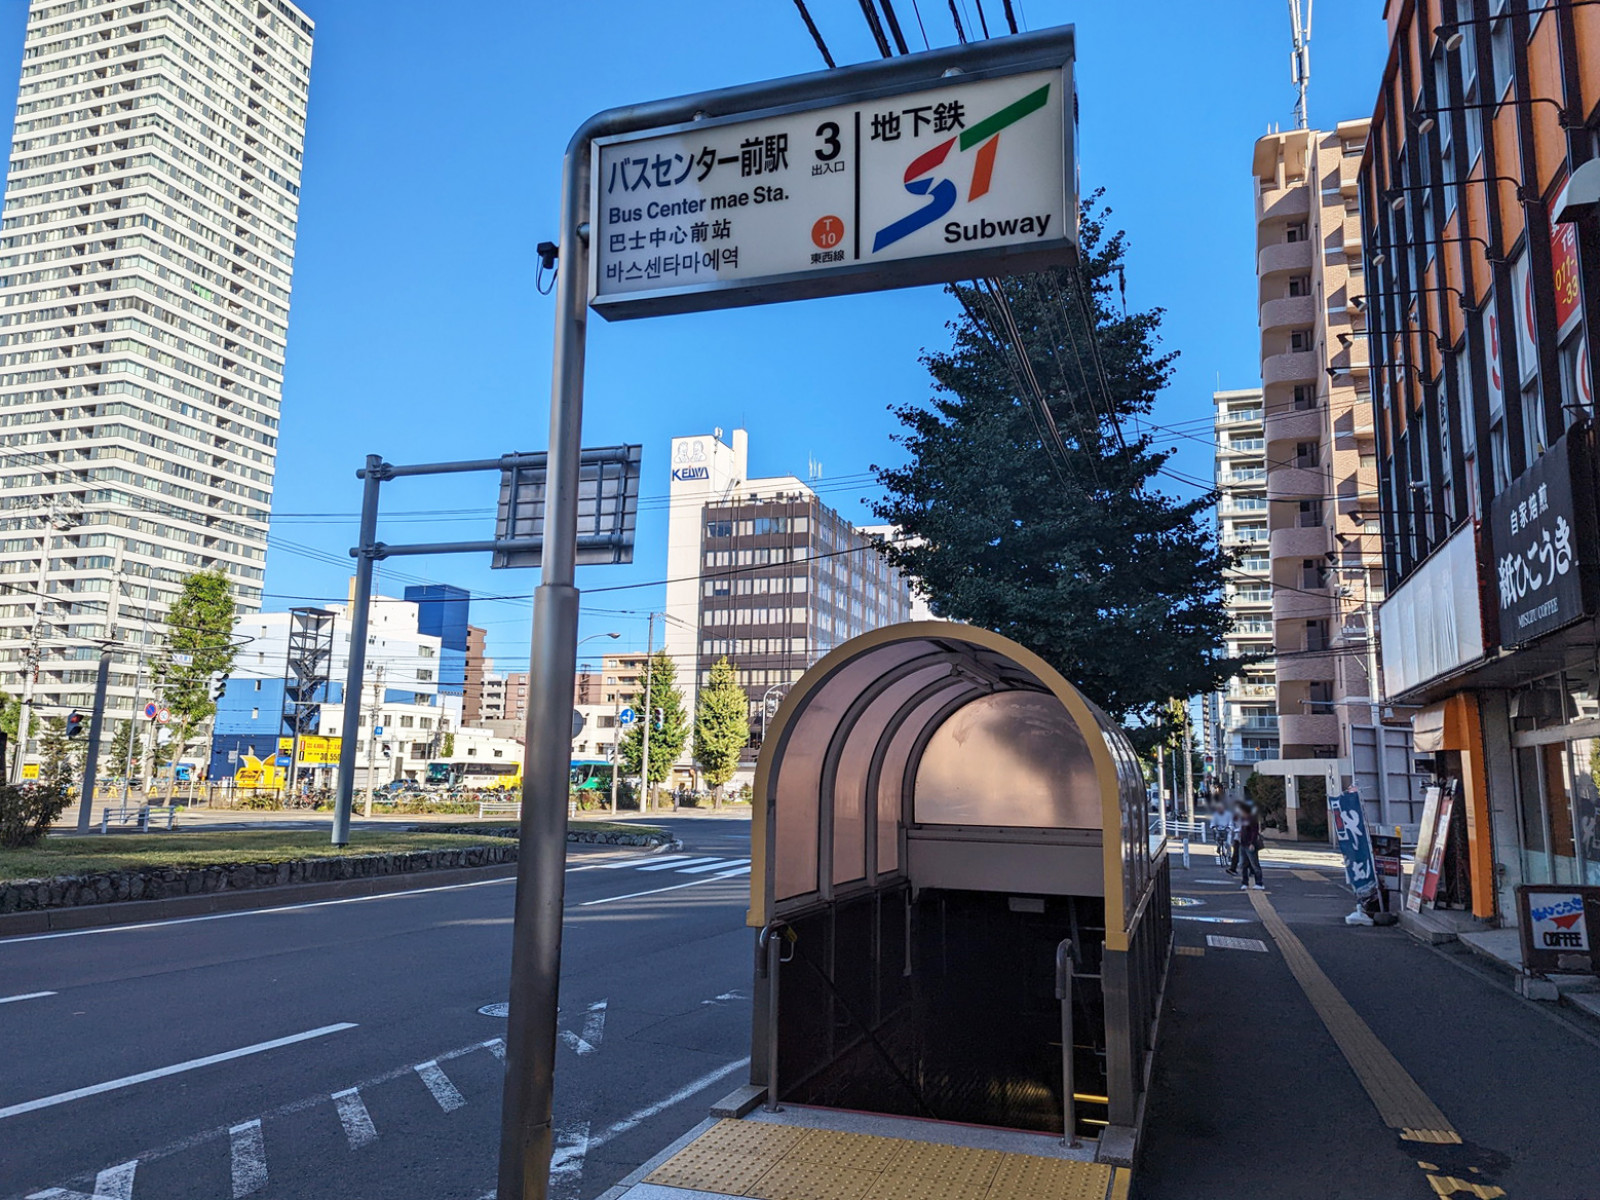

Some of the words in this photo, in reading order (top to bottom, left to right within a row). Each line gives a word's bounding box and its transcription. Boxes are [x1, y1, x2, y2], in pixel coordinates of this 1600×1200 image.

[870, 100, 966, 142] 地下鉄
[814, 121, 842, 162] 3
[608, 133, 789, 194] バスセンター前駅
[811, 161, 845, 176] 出入口
[608, 207, 643, 224] Bus
[646, 197, 707, 219] Center
[710, 192, 749, 211] mae
[753, 185, 789, 204] Sta.
[609, 218, 732, 253] 巴士中心前站
[820, 232, 837, 246] 10
[822, 219, 834, 231] T
[943, 214, 1052, 244] Subway
[606, 246, 739, 283] 바스센타마에역
[810, 250, 846, 265] 東西線
[1509, 482, 1549, 536] 自家焙煎
[1498, 515, 1572, 610] 紙ひこうき
[1543, 931, 1583, 947] COFFEE
